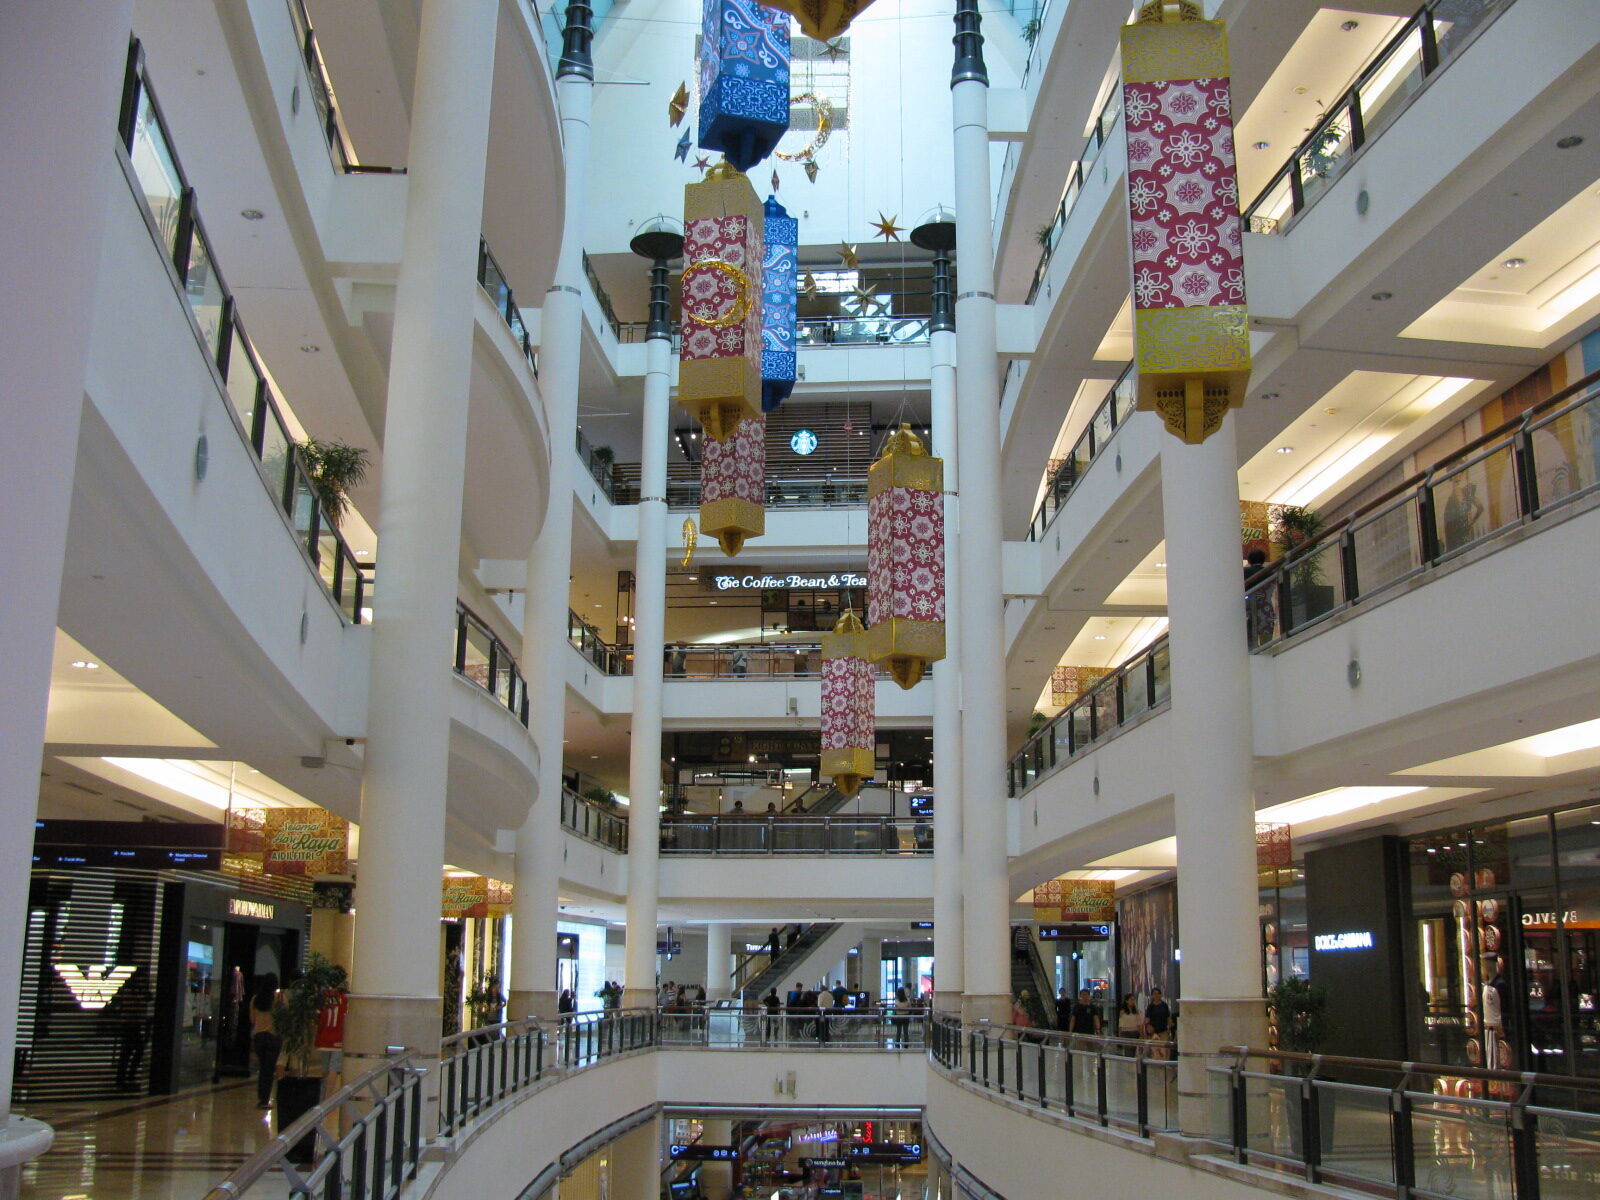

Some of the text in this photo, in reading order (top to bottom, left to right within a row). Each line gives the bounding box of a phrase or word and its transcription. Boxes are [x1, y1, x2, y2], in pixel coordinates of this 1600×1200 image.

[715, 573, 867, 590] The Coffee Bean & Tea
[911, 797, 919, 807] 2
[283, 821, 322, 832] Selamat
[292, 834, 341, 857] Raya
[271, 851, 315, 862] AIDILFITRI
[455, 893, 484, 907] Raya
[1099, 925, 1109, 935] G
[671, 1145, 680, 1155] C
[912, 1144, 921, 1154] C
